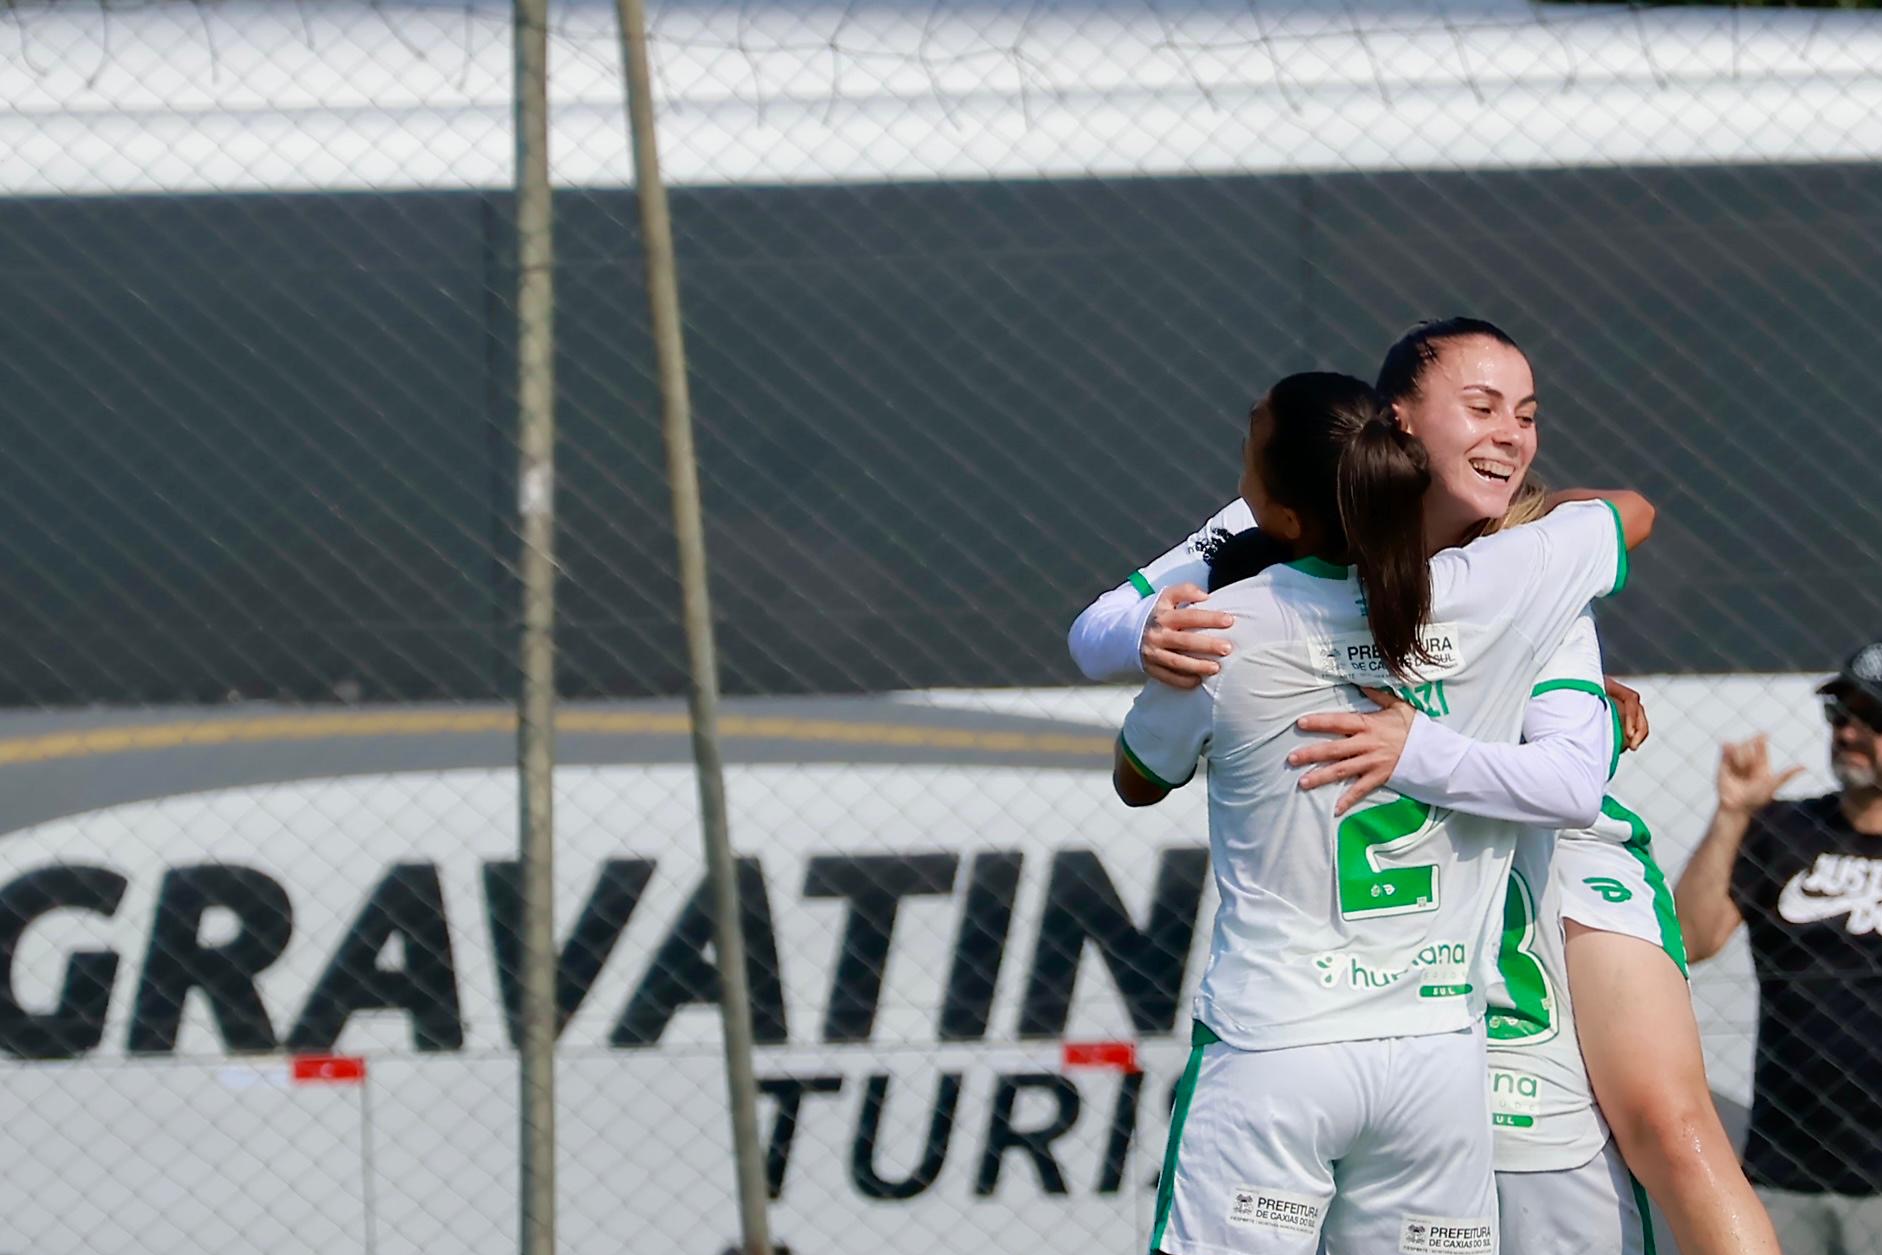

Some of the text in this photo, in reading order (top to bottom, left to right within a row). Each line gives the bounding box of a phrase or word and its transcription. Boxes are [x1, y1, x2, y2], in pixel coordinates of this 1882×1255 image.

[1352, 661, 1367, 672] DE
[1336, 797, 1440, 921] 2
[1495, 1114, 1516, 1126] UL
[757, 1071, 1180, 1200] TURI
[1258, 1197, 1319, 1218] PREFEITURA
[1256, 1209, 1269, 1219] DE
[1270, 1211, 1298, 1225] CAXIAS
[1430, 1226, 1491, 1240] PREFEITURA
[1429, 1238, 1442, 1247] DE
[1443, 1239, 1472, 1249] CAXIAS
